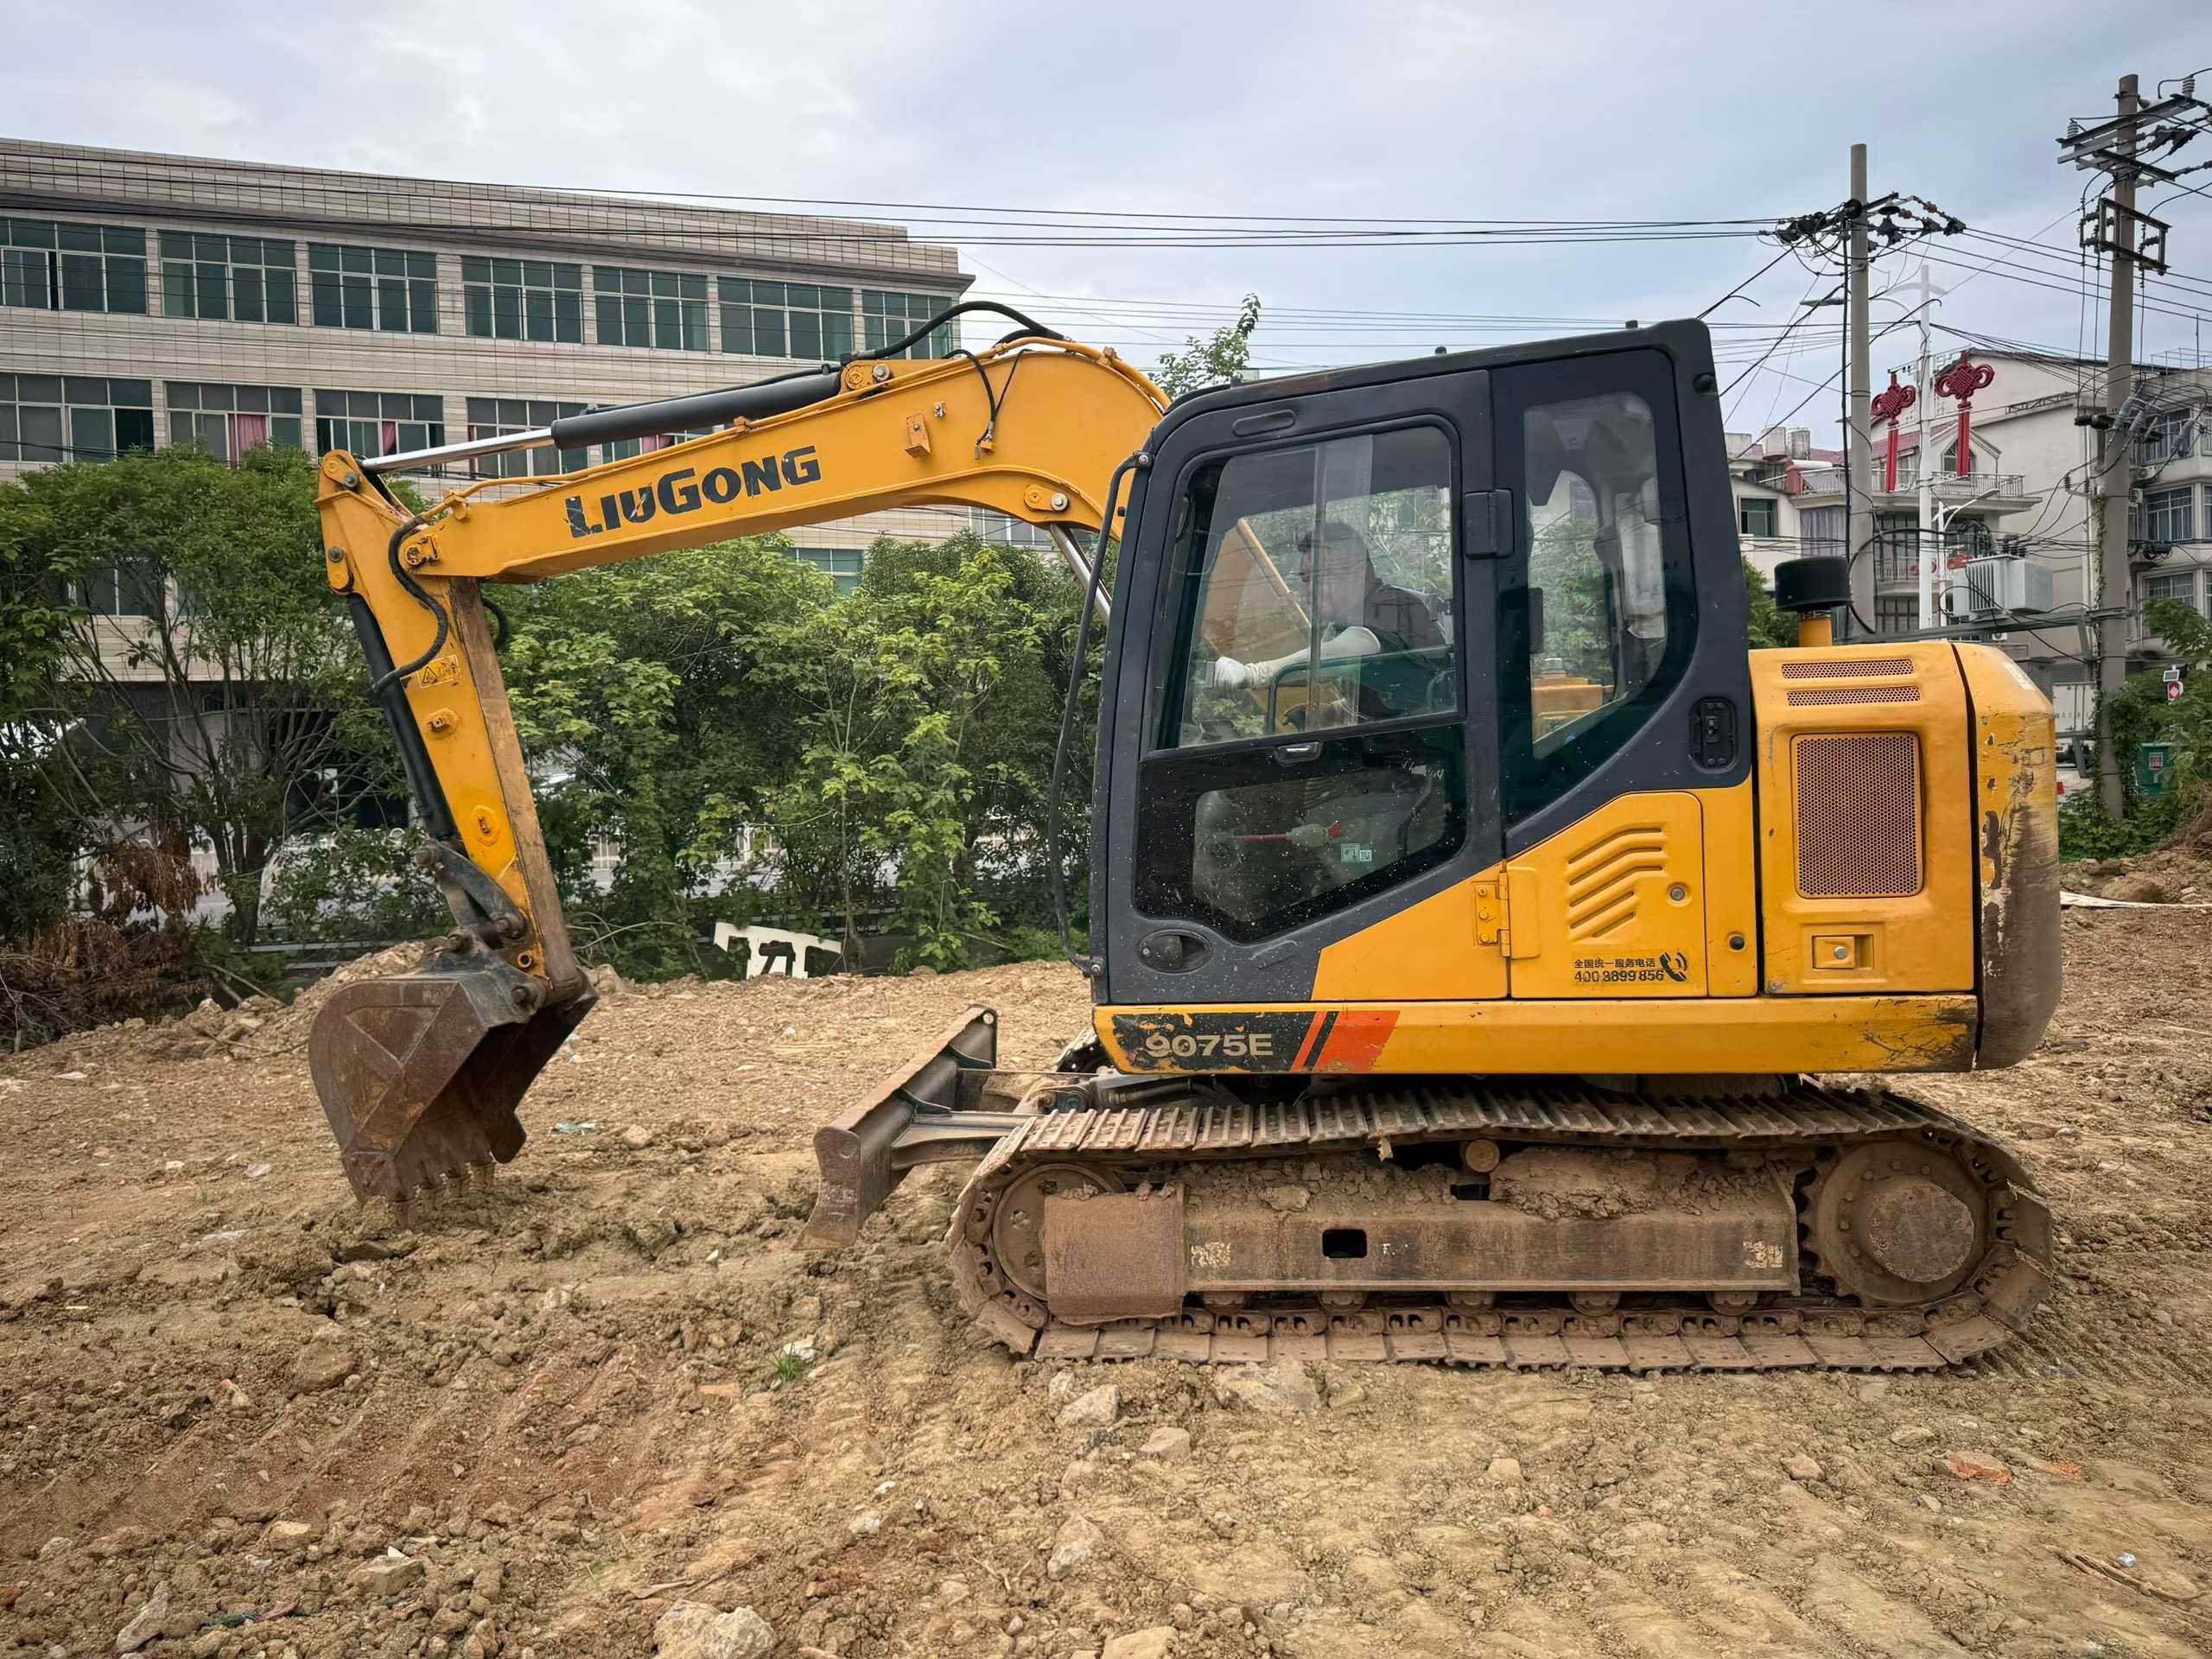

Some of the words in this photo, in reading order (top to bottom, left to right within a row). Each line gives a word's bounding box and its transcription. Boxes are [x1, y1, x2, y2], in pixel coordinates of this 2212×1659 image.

[564, 445, 821, 538] LIUGONG
[1574, 958, 1656, 968] 全国统一服务电话
[1638, 969, 1664, 982] 856
[1146, 1033, 1274, 1058] 9075E
